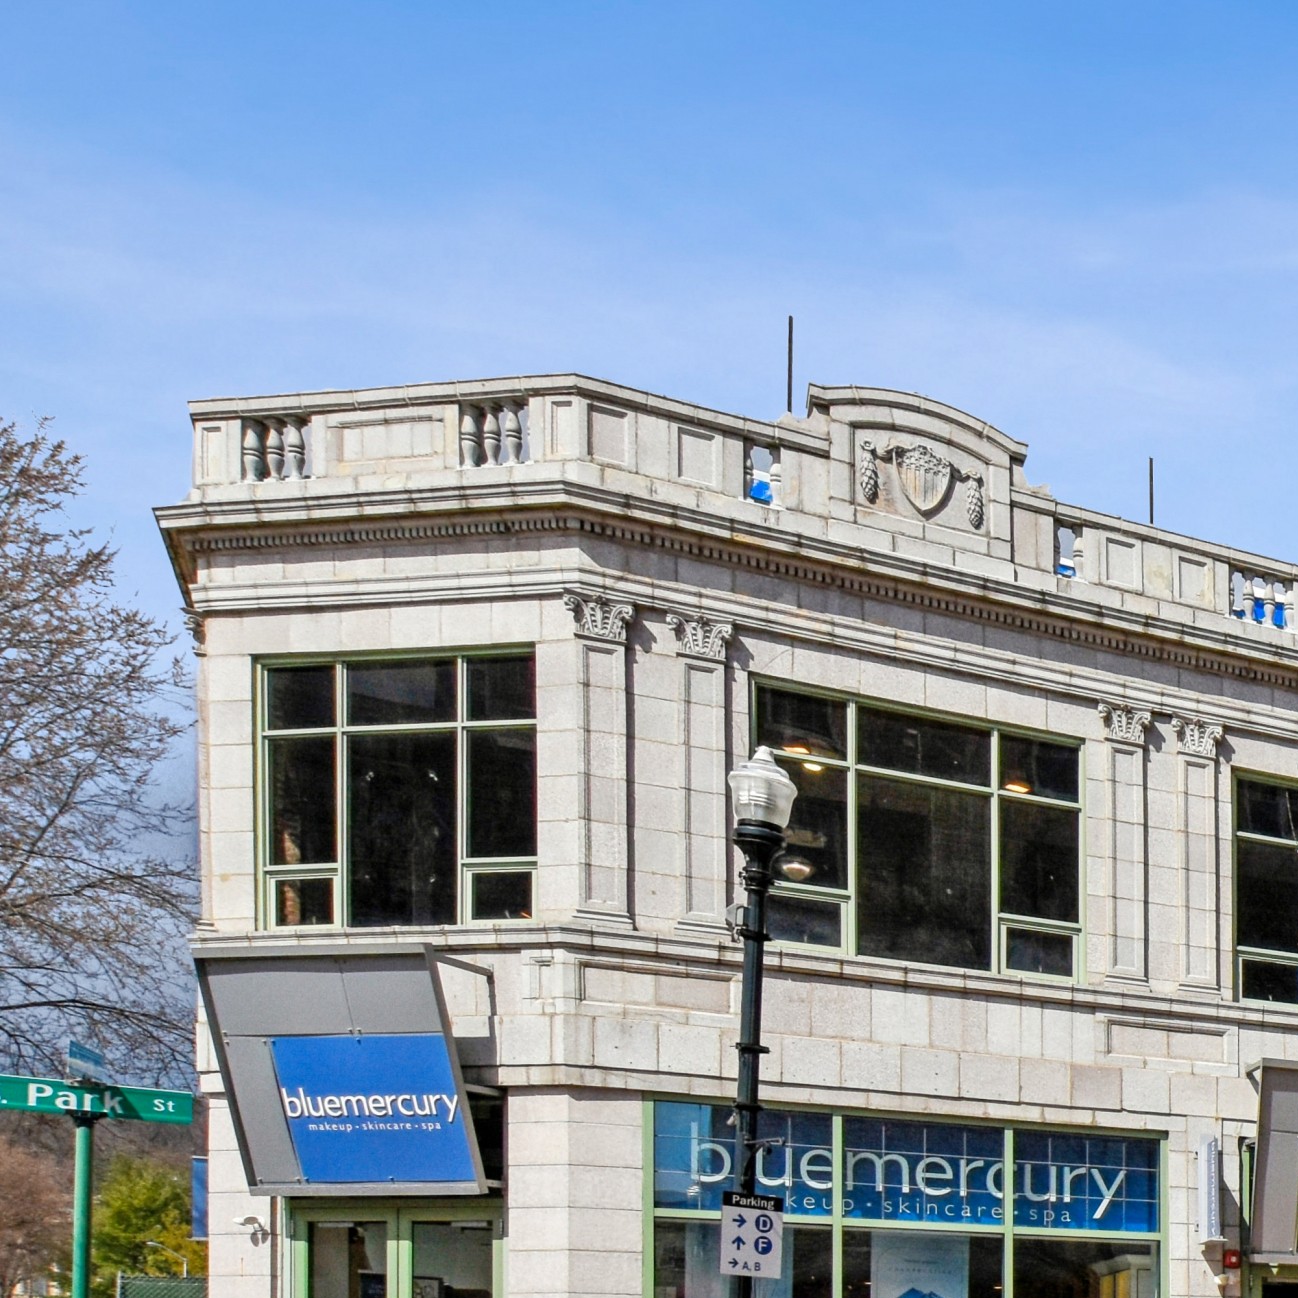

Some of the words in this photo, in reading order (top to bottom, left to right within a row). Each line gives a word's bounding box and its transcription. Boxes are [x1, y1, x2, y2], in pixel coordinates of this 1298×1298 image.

[27, 1083, 124, 1114] Park
[153, 1098, 176, 1112] St
[281, 1087, 458, 1123] bluemercury
[308, 1121, 353, 1132] makeup
[361, 1121, 412, 1131] skincare
[421, 1122, 442, 1132] spa
[690, 1121, 1127, 1220] buemercury
[732, 1194, 775, 1210] Parking
[785, 1191, 854, 1214] keup
[883, 1197, 1004, 1219] skincare
[1029, 1206, 1072, 1226] spa
[759, 1217, 771, 1231] D
[758, 1238, 768, 1252] F
[754, 1262, 761, 1271] B
